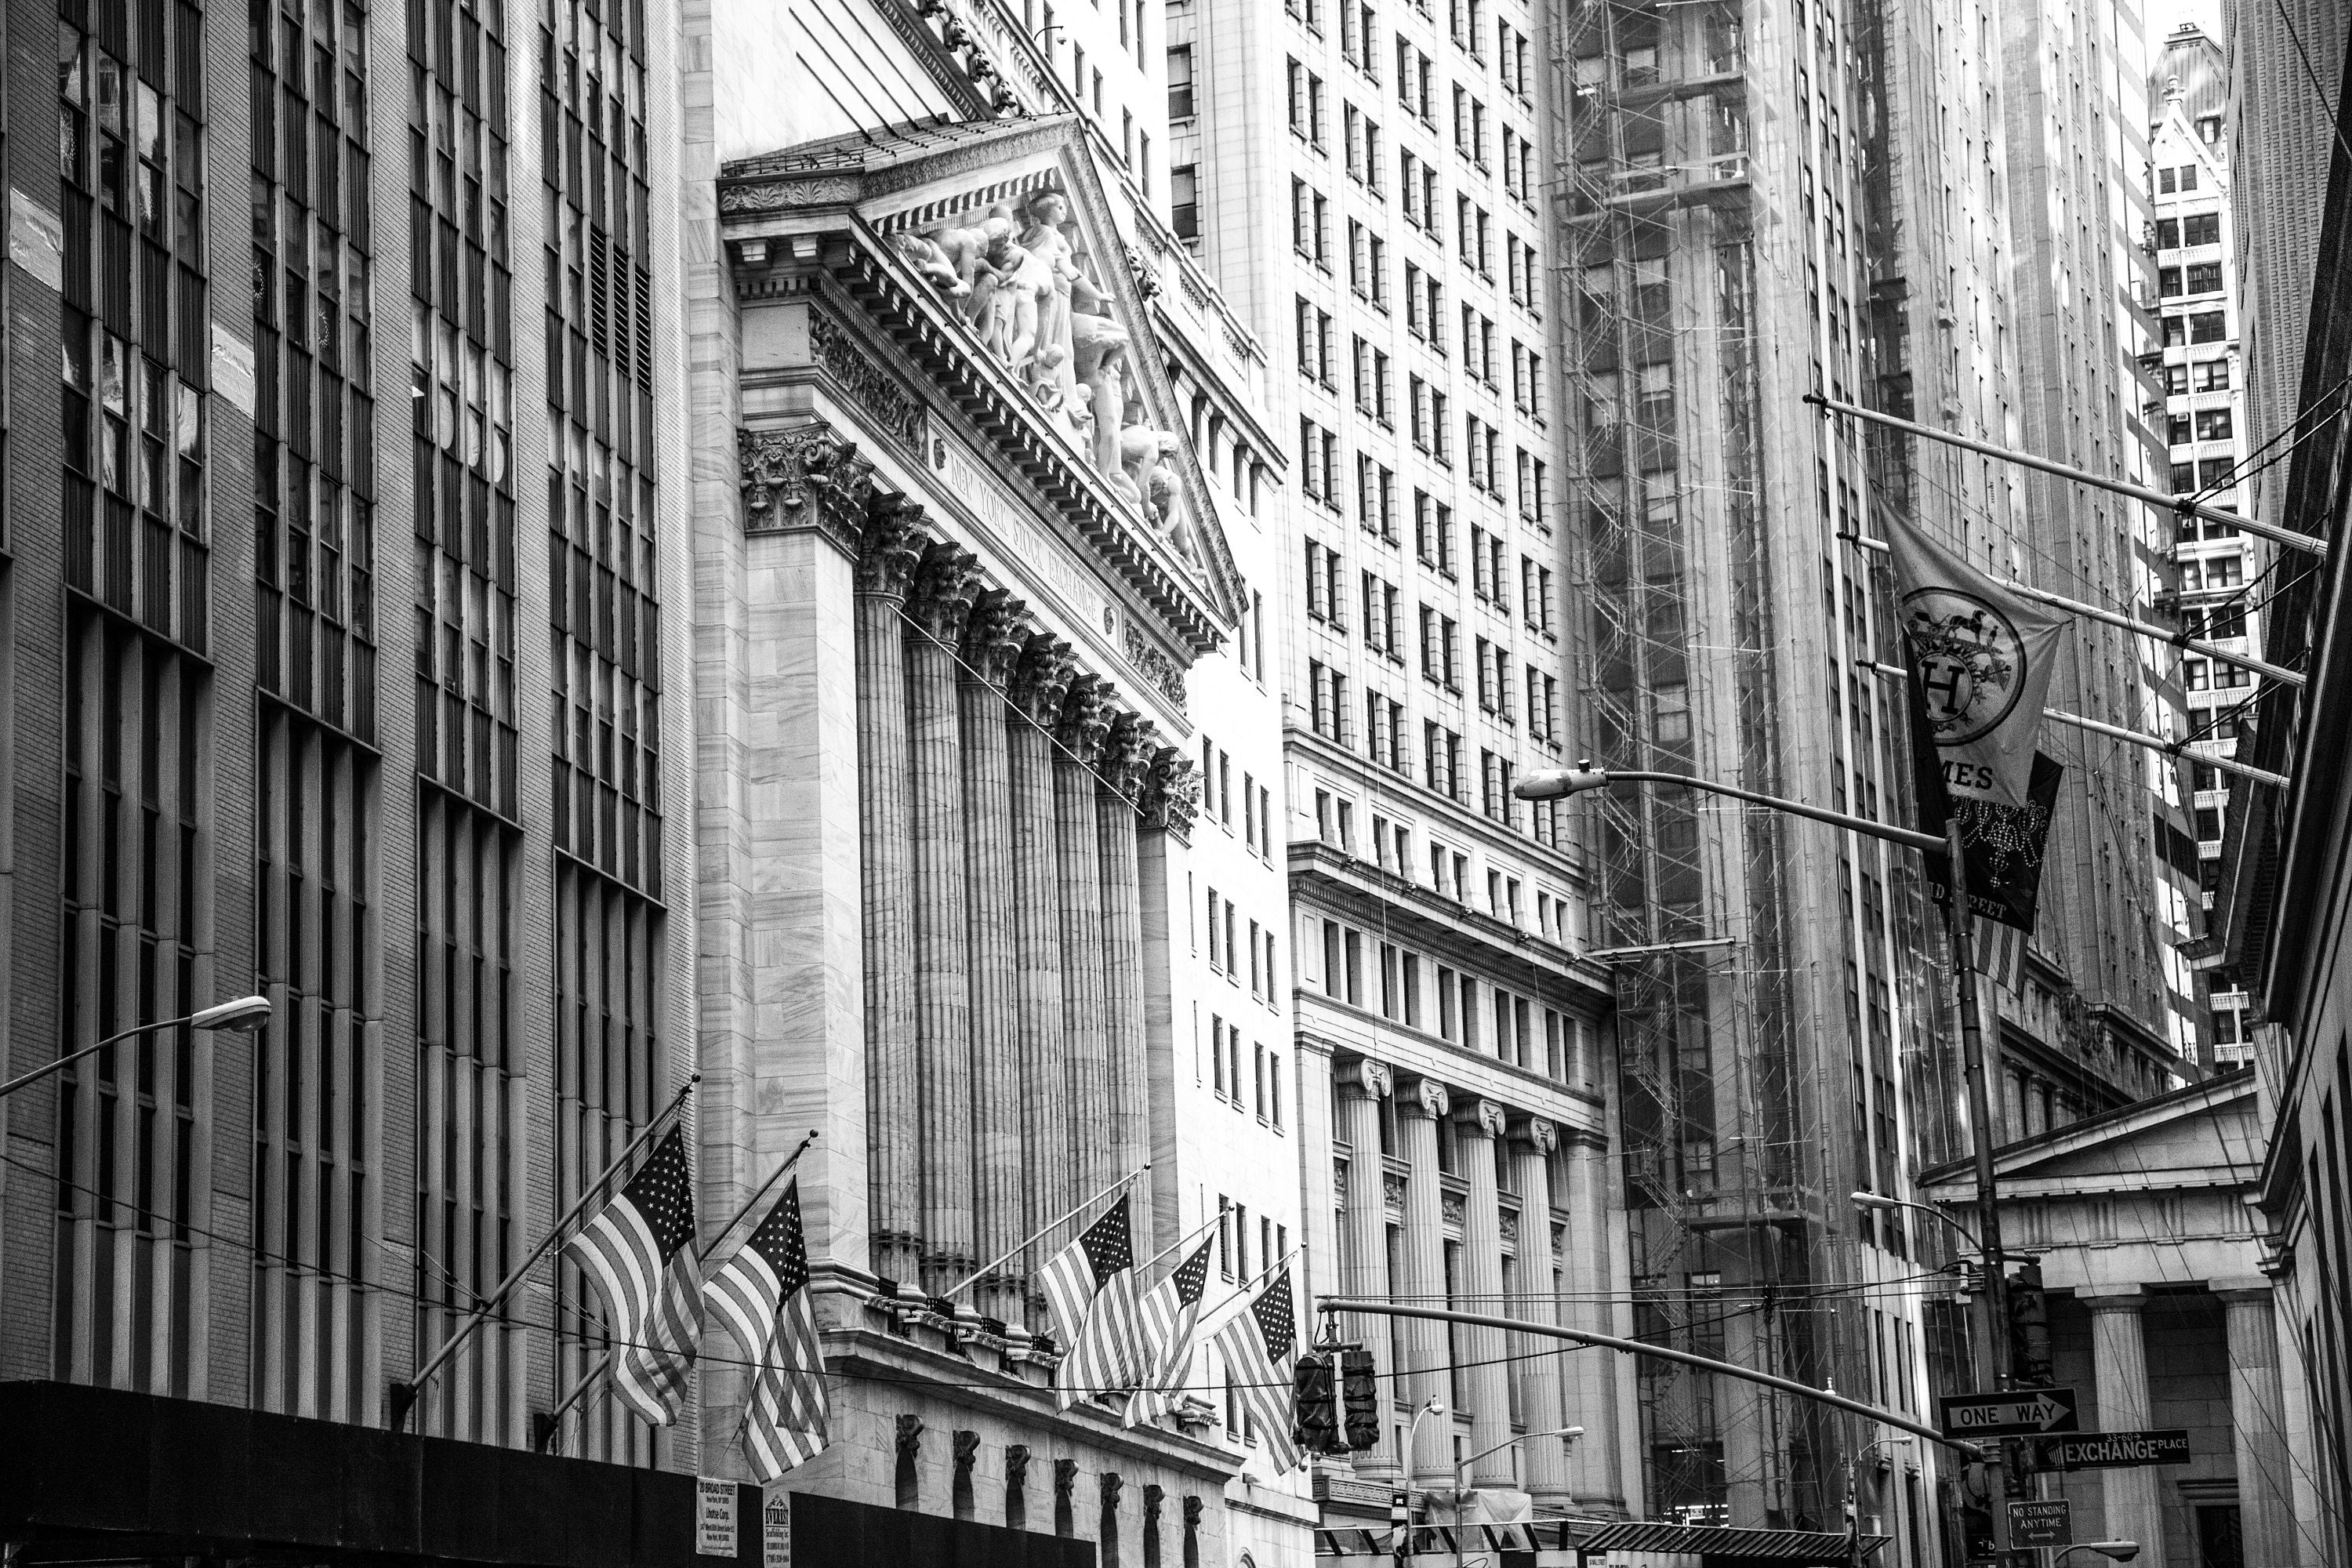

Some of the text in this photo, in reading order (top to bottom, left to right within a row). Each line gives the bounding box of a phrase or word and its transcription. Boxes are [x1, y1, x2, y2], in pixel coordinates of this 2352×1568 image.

[951, 454, 1098, 622] NEW YORK STOCK EXCHANGE
[1921, 661, 1965, 715] H
[1960, 1403, 2056, 1425] ONE WAY
[2106, 1432, 2132, 1443] 33-60
[2064, 1438, 2188, 1463] EXCHANGE PLACE
[705, 1482, 720, 1494] BROAD
[720, 1483, 735, 1496] STREET
[765, 1508, 789, 1526] EVEREST
[2013, 1504, 2067, 1518] NO STANDING
[2020, 1518, 2062, 1530] ANYTIME
